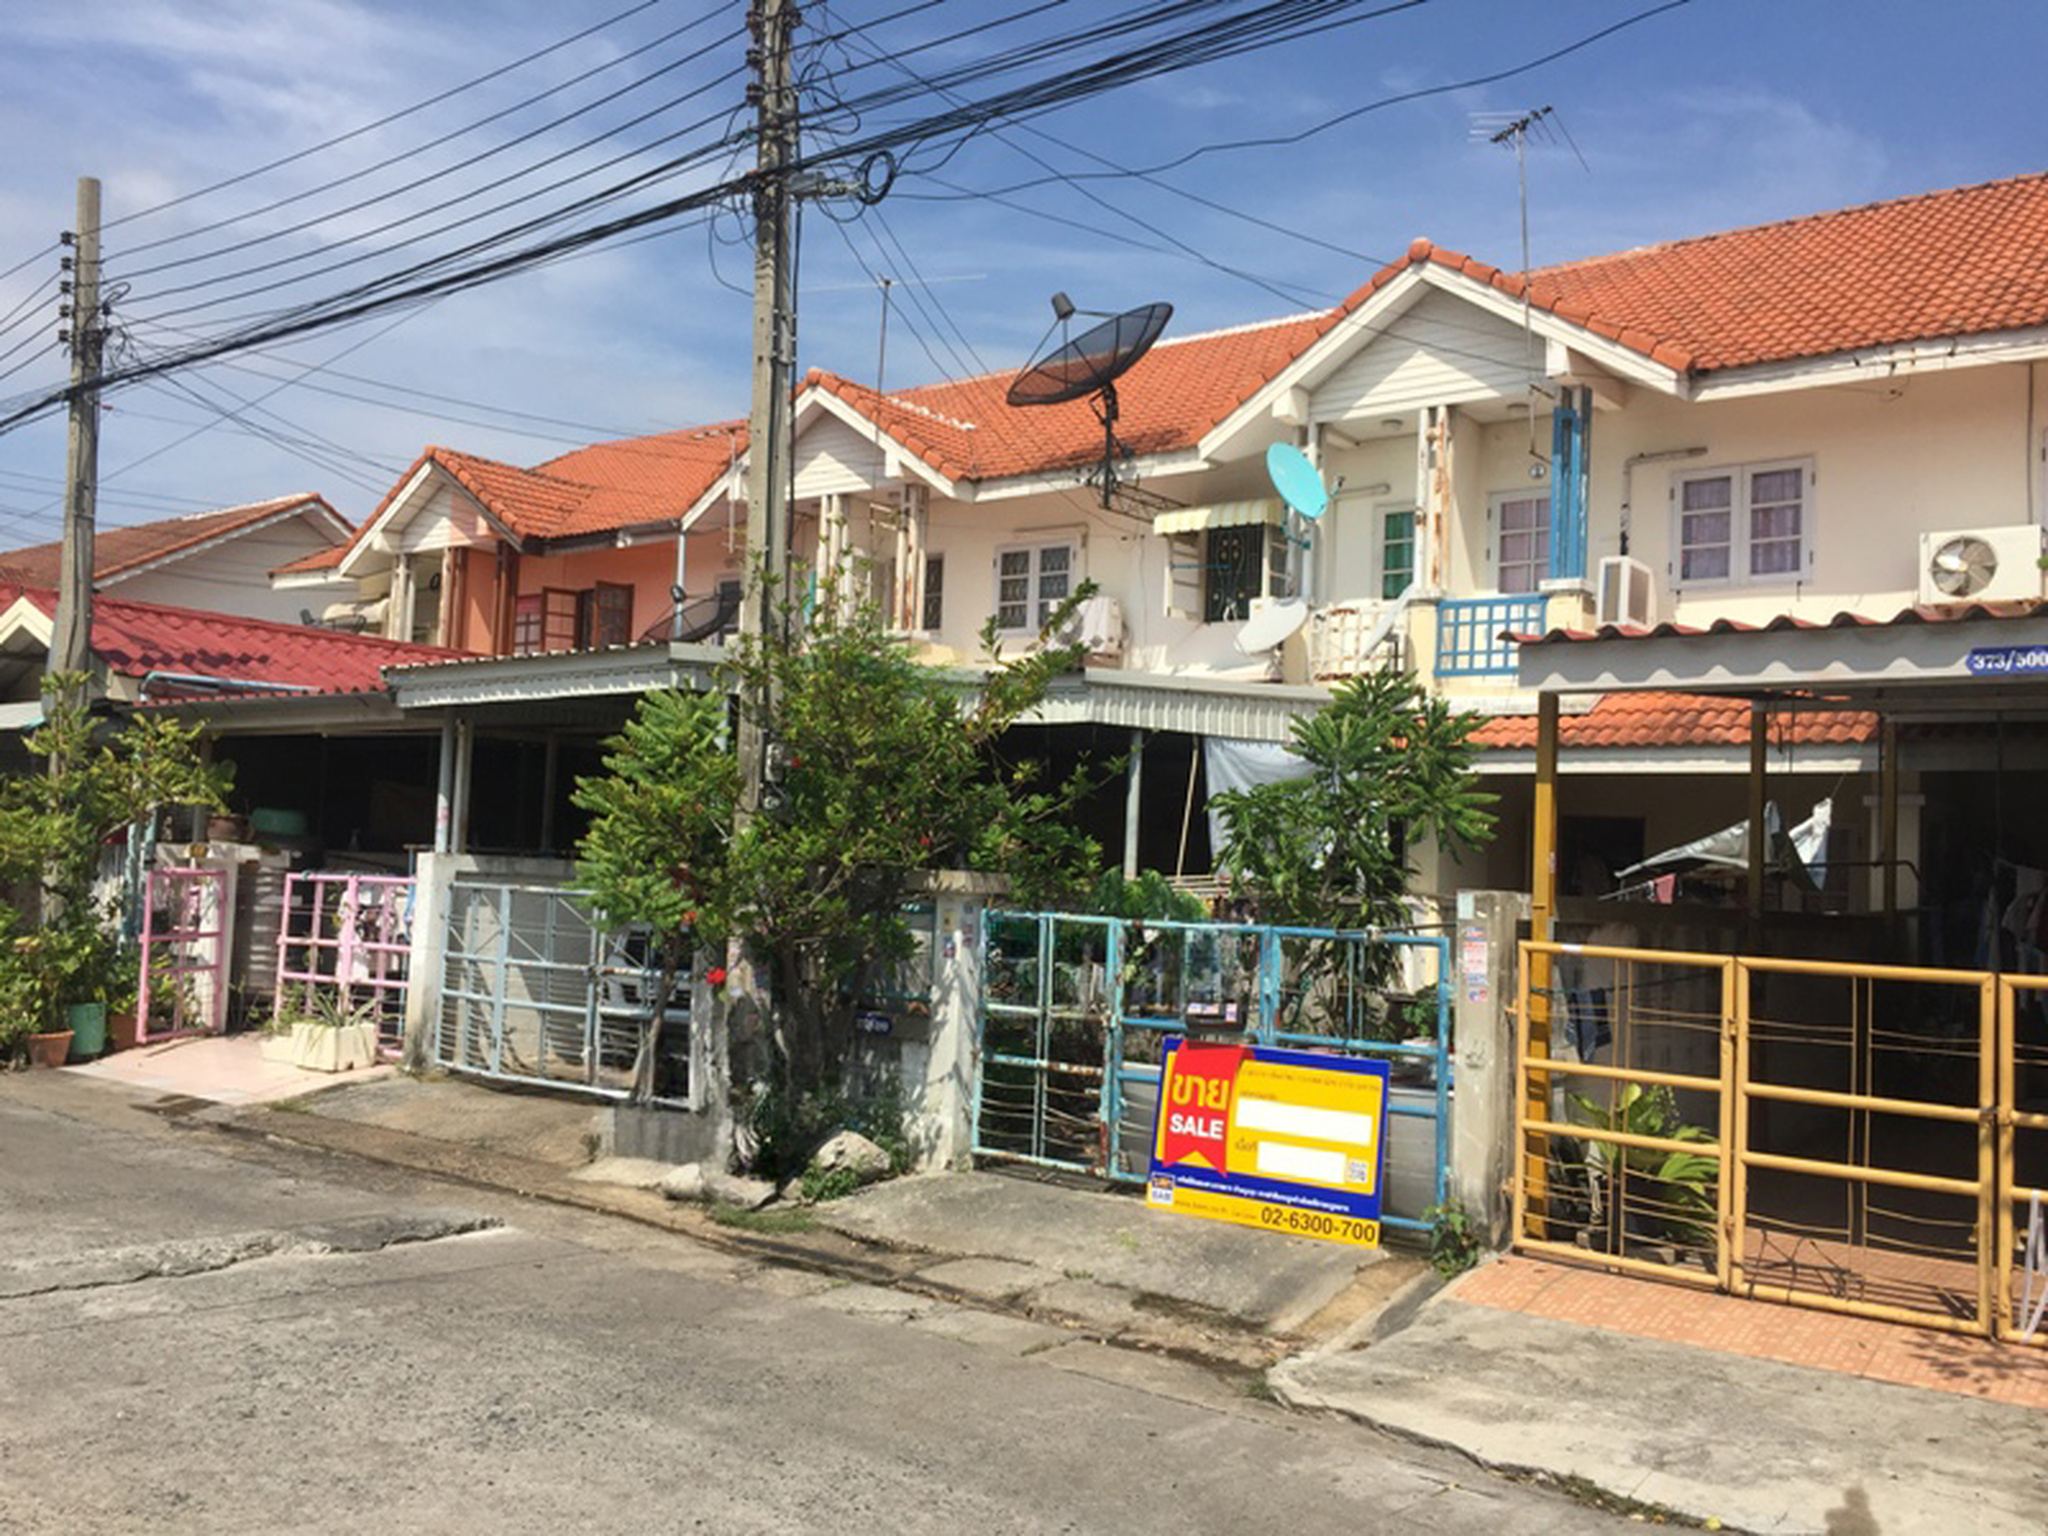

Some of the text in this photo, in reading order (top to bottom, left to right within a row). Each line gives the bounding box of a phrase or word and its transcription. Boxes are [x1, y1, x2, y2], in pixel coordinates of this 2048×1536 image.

[1172, 1073, 1229, 1111] ขาย
[1169, 1112, 1224, 1141] SALE
[1261, 1206, 1375, 1242] 02-6300-700
